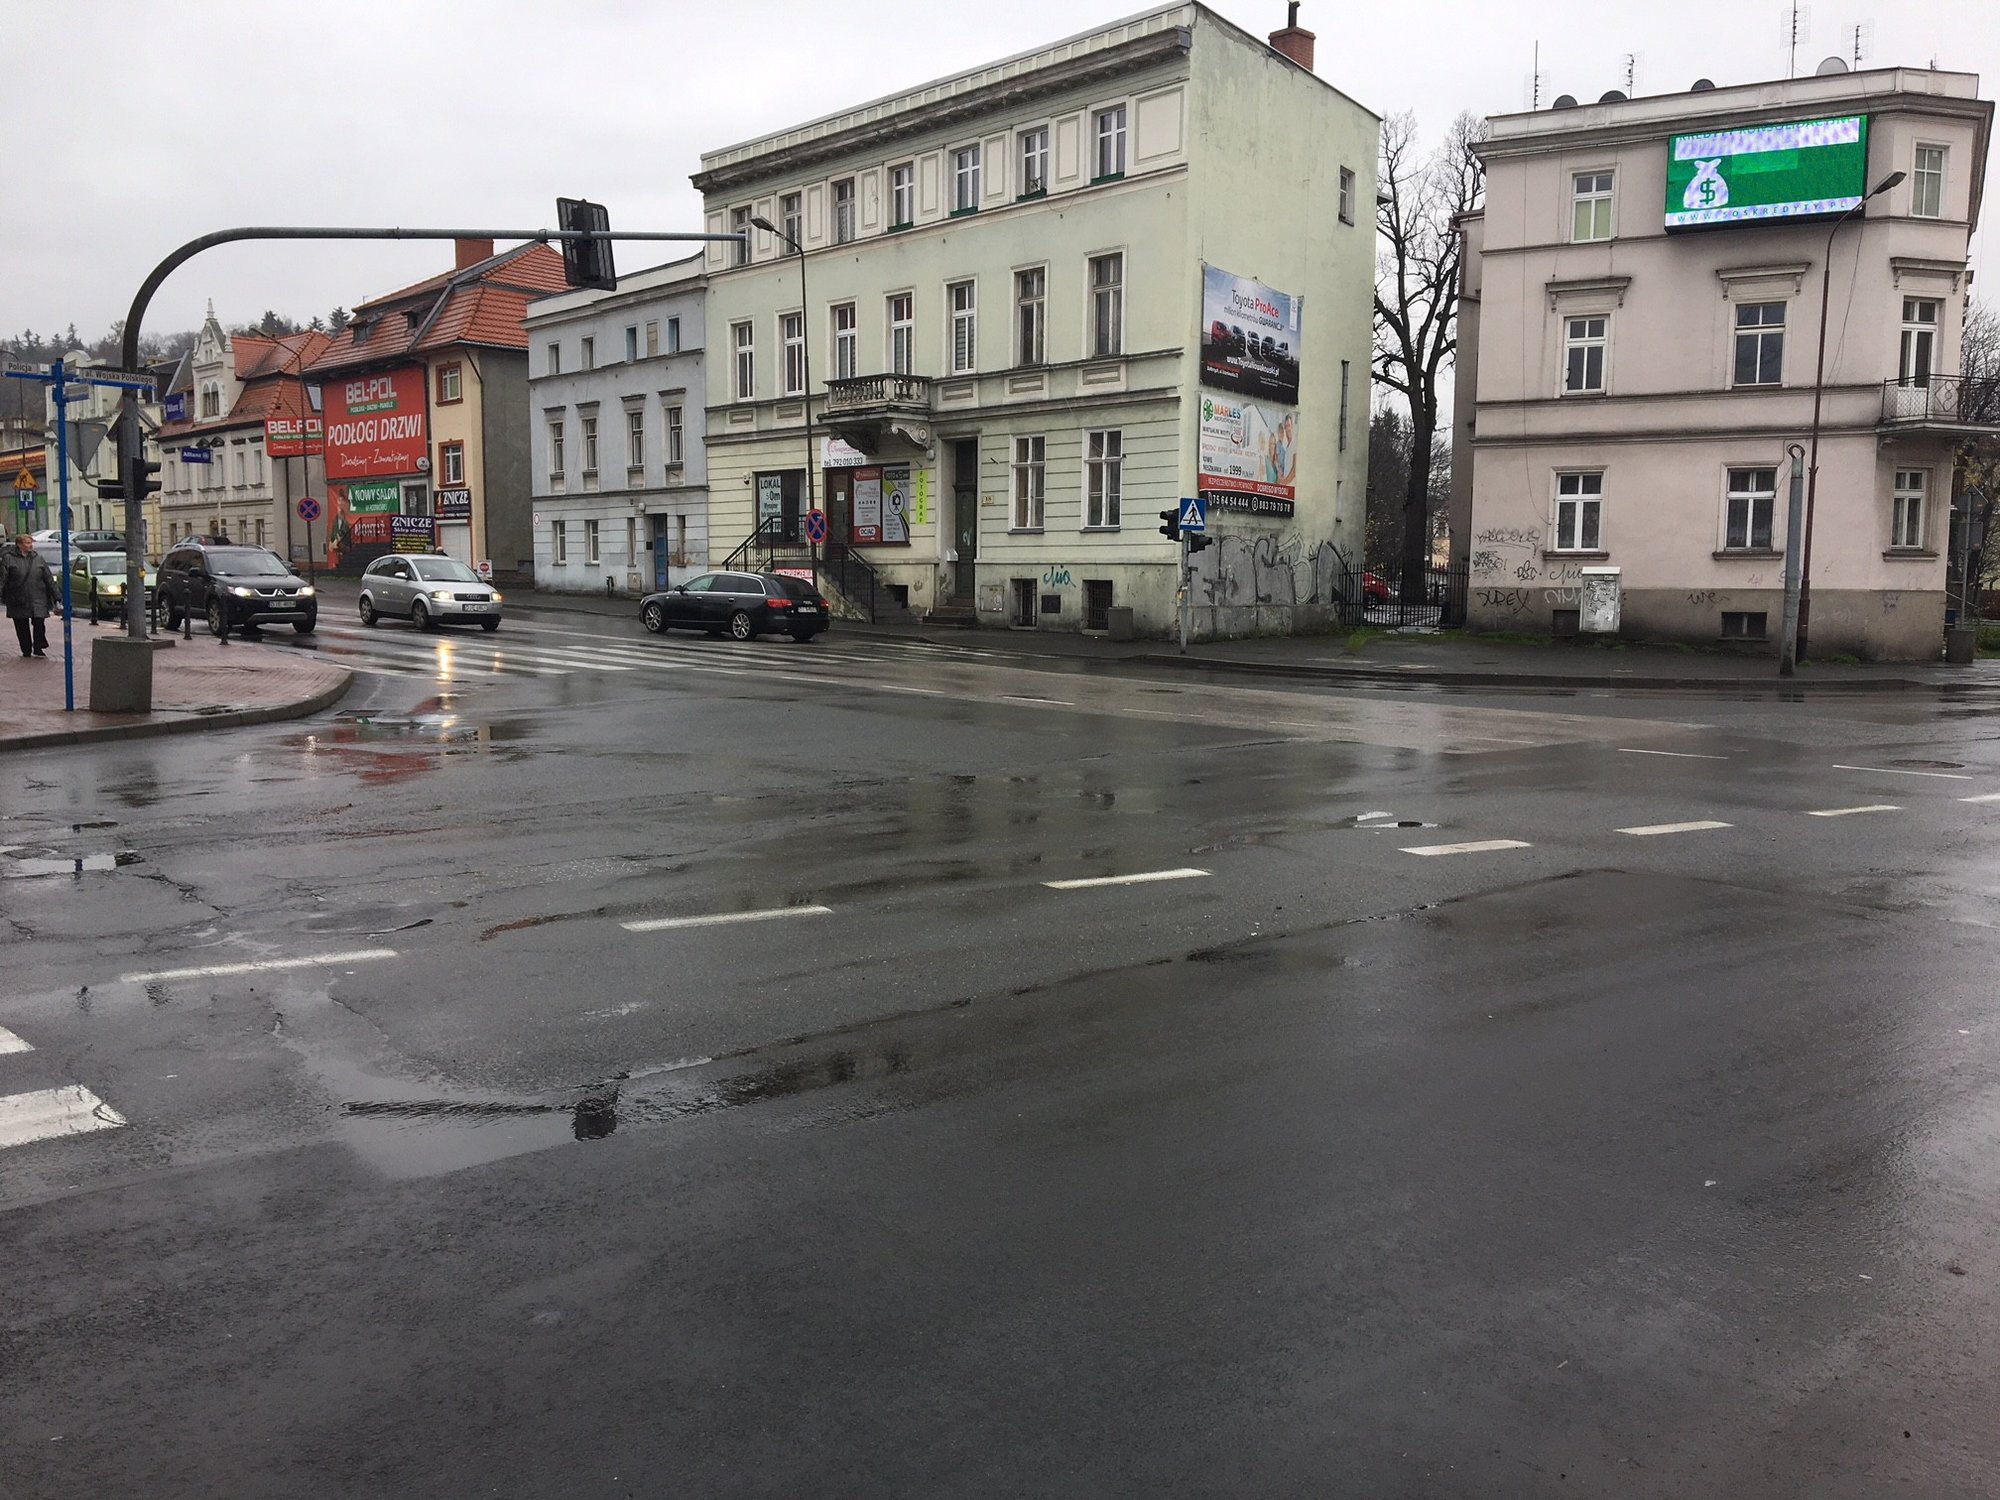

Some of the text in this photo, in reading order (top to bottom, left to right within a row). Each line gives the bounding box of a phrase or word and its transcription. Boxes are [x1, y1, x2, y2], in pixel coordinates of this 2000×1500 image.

[1232, 289, 1280, 318] Toyota ProAce
[8, 362, 32, 372] Policja
[96, 371, 120, 381] Wojska
[121, 374, 153, 384] Polskiego
[1214, 404, 1241, 419] MARLES
[328, 414, 422, 447] PODŁOGI DRZWI
[832, 458, 842, 466] 792
[842, 458, 852, 466] 010
[853, 457, 862, 465] 333
[1229, 465, 1242, 476] 1999
[760, 479, 781, 490] LOKAL
[354, 488, 376, 501] NOWY
[376, 487, 398, 500] SALON
[443, 490, 469, 505] ZNICZE
[1212, 494, 1220, 505] 75
[1221, 495, 1228, 505] 64
[1229, 496, 1237, 506] 54
[1238, 497, 1249, 508] 444
[391, 516, 433, 528] ZNICZE
